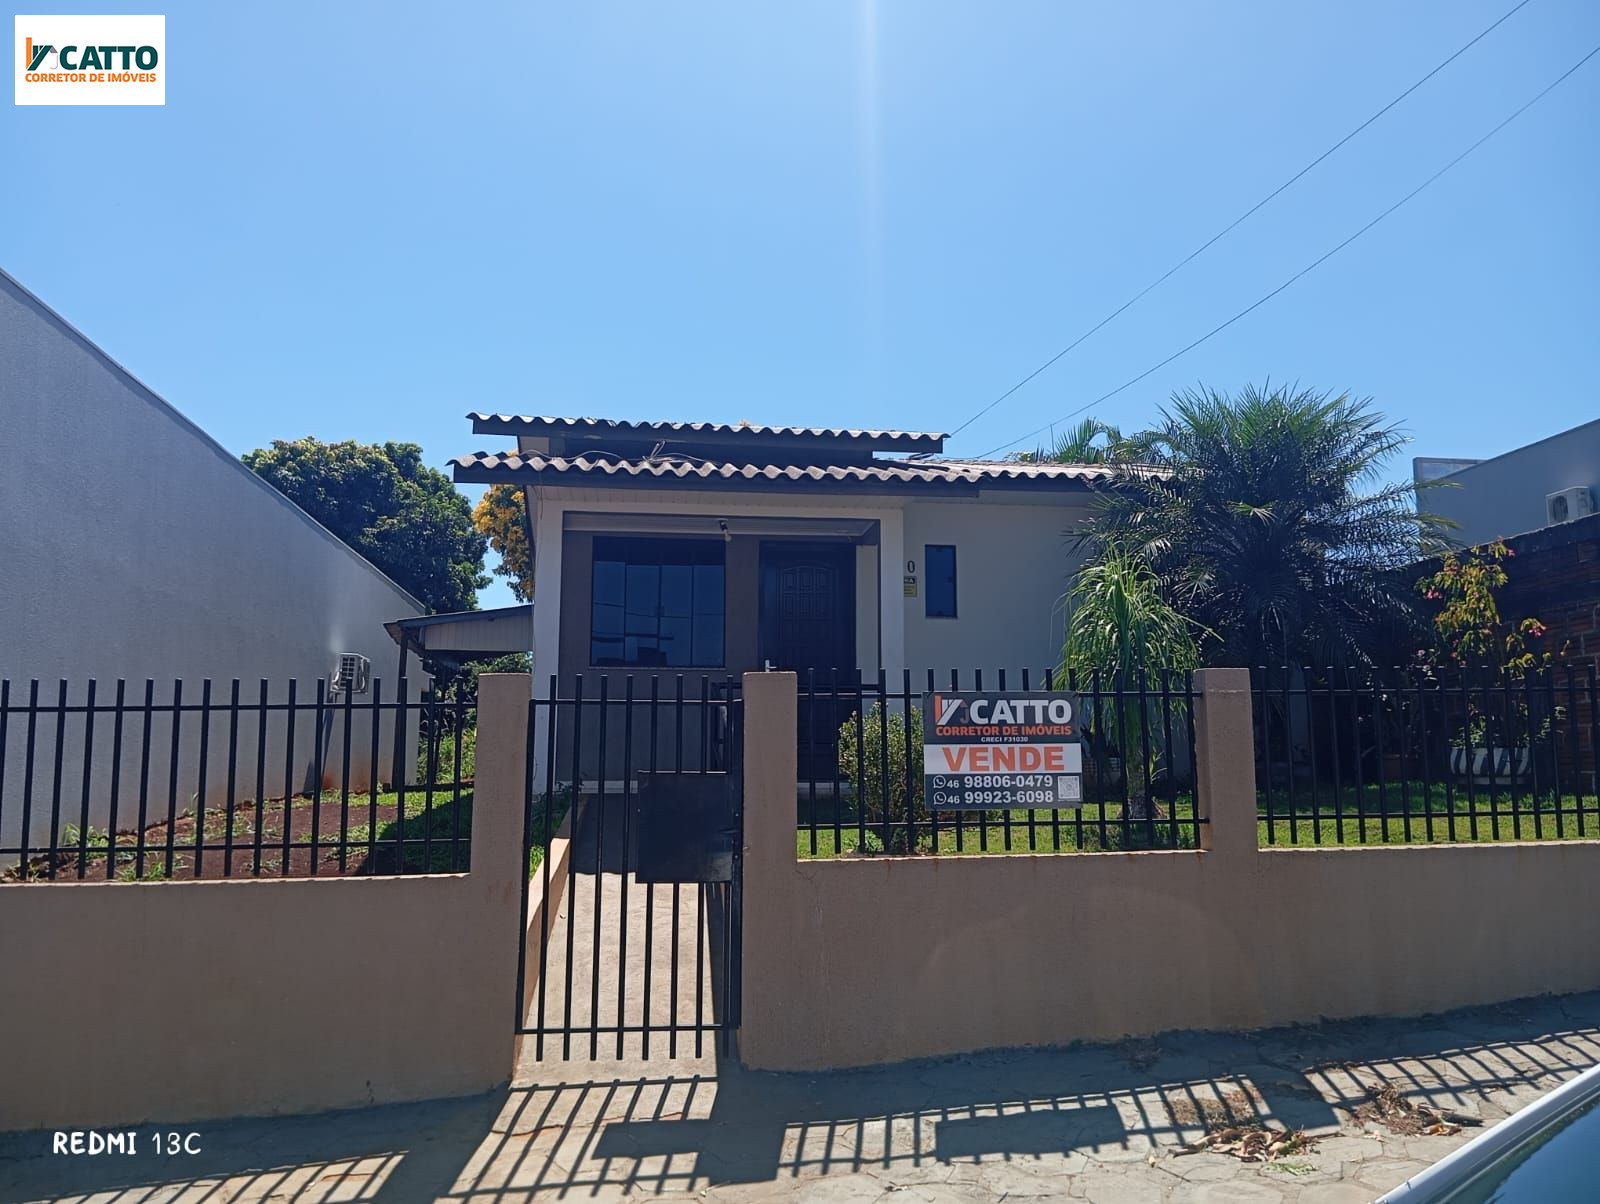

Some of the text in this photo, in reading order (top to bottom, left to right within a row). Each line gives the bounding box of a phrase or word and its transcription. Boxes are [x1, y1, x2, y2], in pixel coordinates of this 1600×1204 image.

[935, 724, 1072, 736] CORRETOR DE IMÓVEIS
[942, 746, 1065, 772] VENDE
[946, 775, 1053, 789] 46 98806-0479
[947, 790, 1054, 804] 46 99923-6098
